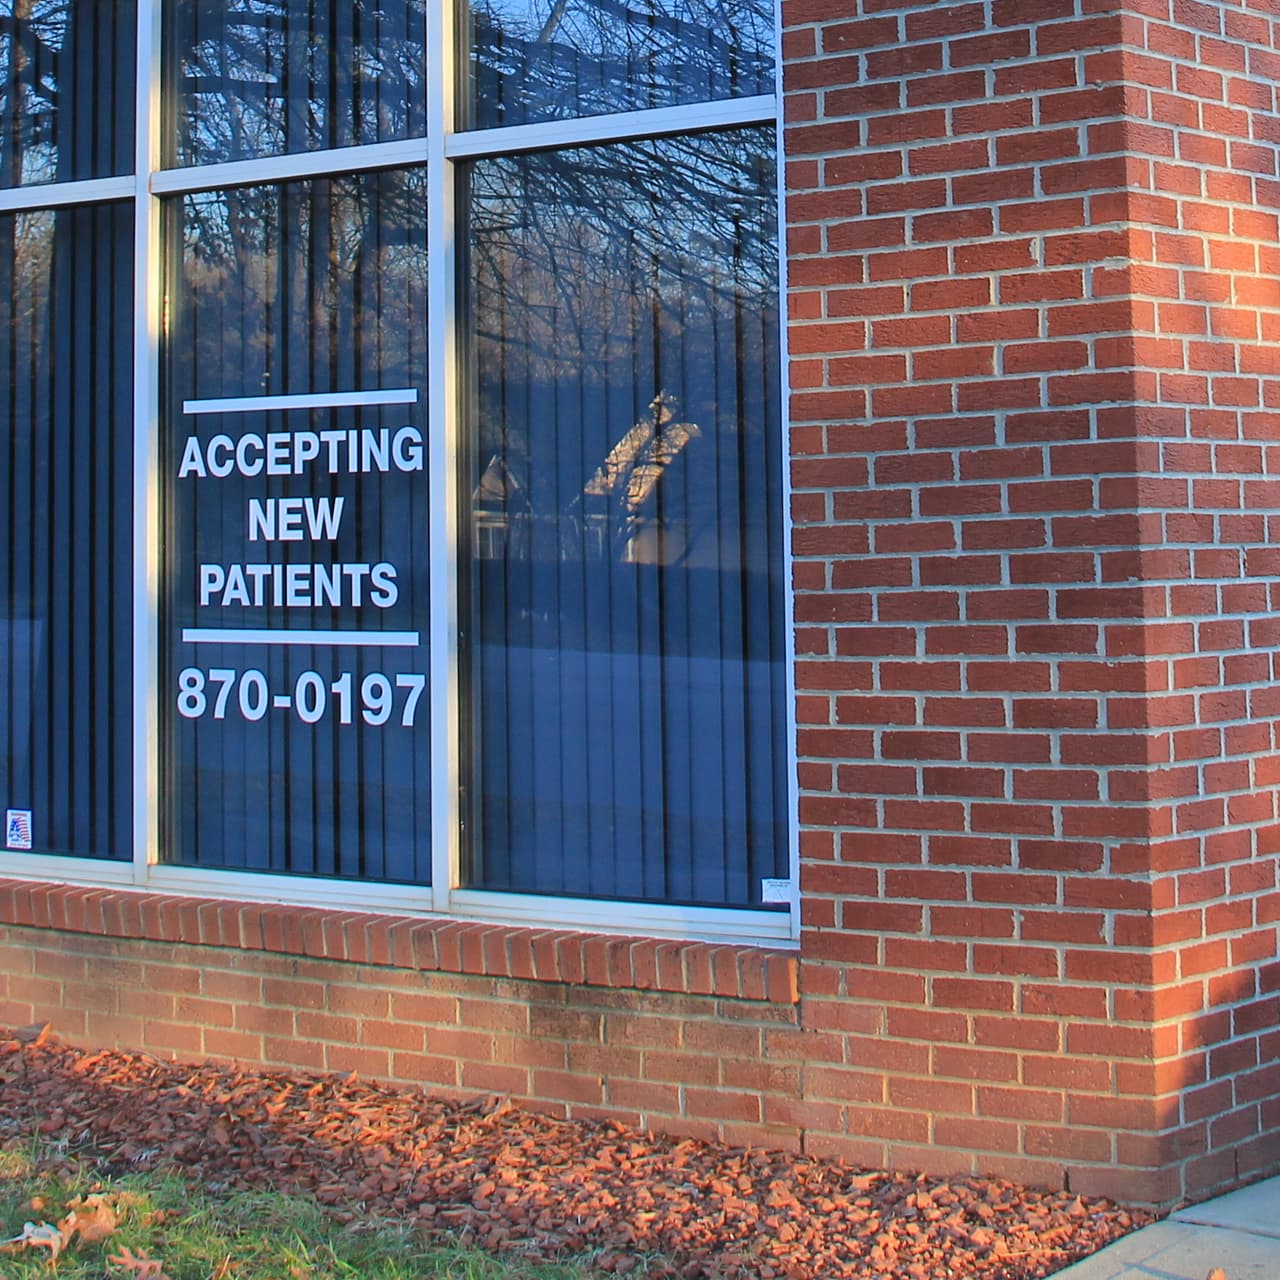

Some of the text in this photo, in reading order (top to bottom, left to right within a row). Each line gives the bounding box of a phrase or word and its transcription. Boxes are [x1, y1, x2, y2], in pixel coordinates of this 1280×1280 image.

[178, 426, 424, 478] ACCEPTING
[248, 496, 344, 541] NEW
[200, 562, 399, 608] PATIENTS
[176, 667, 426, 726] 870-0197
